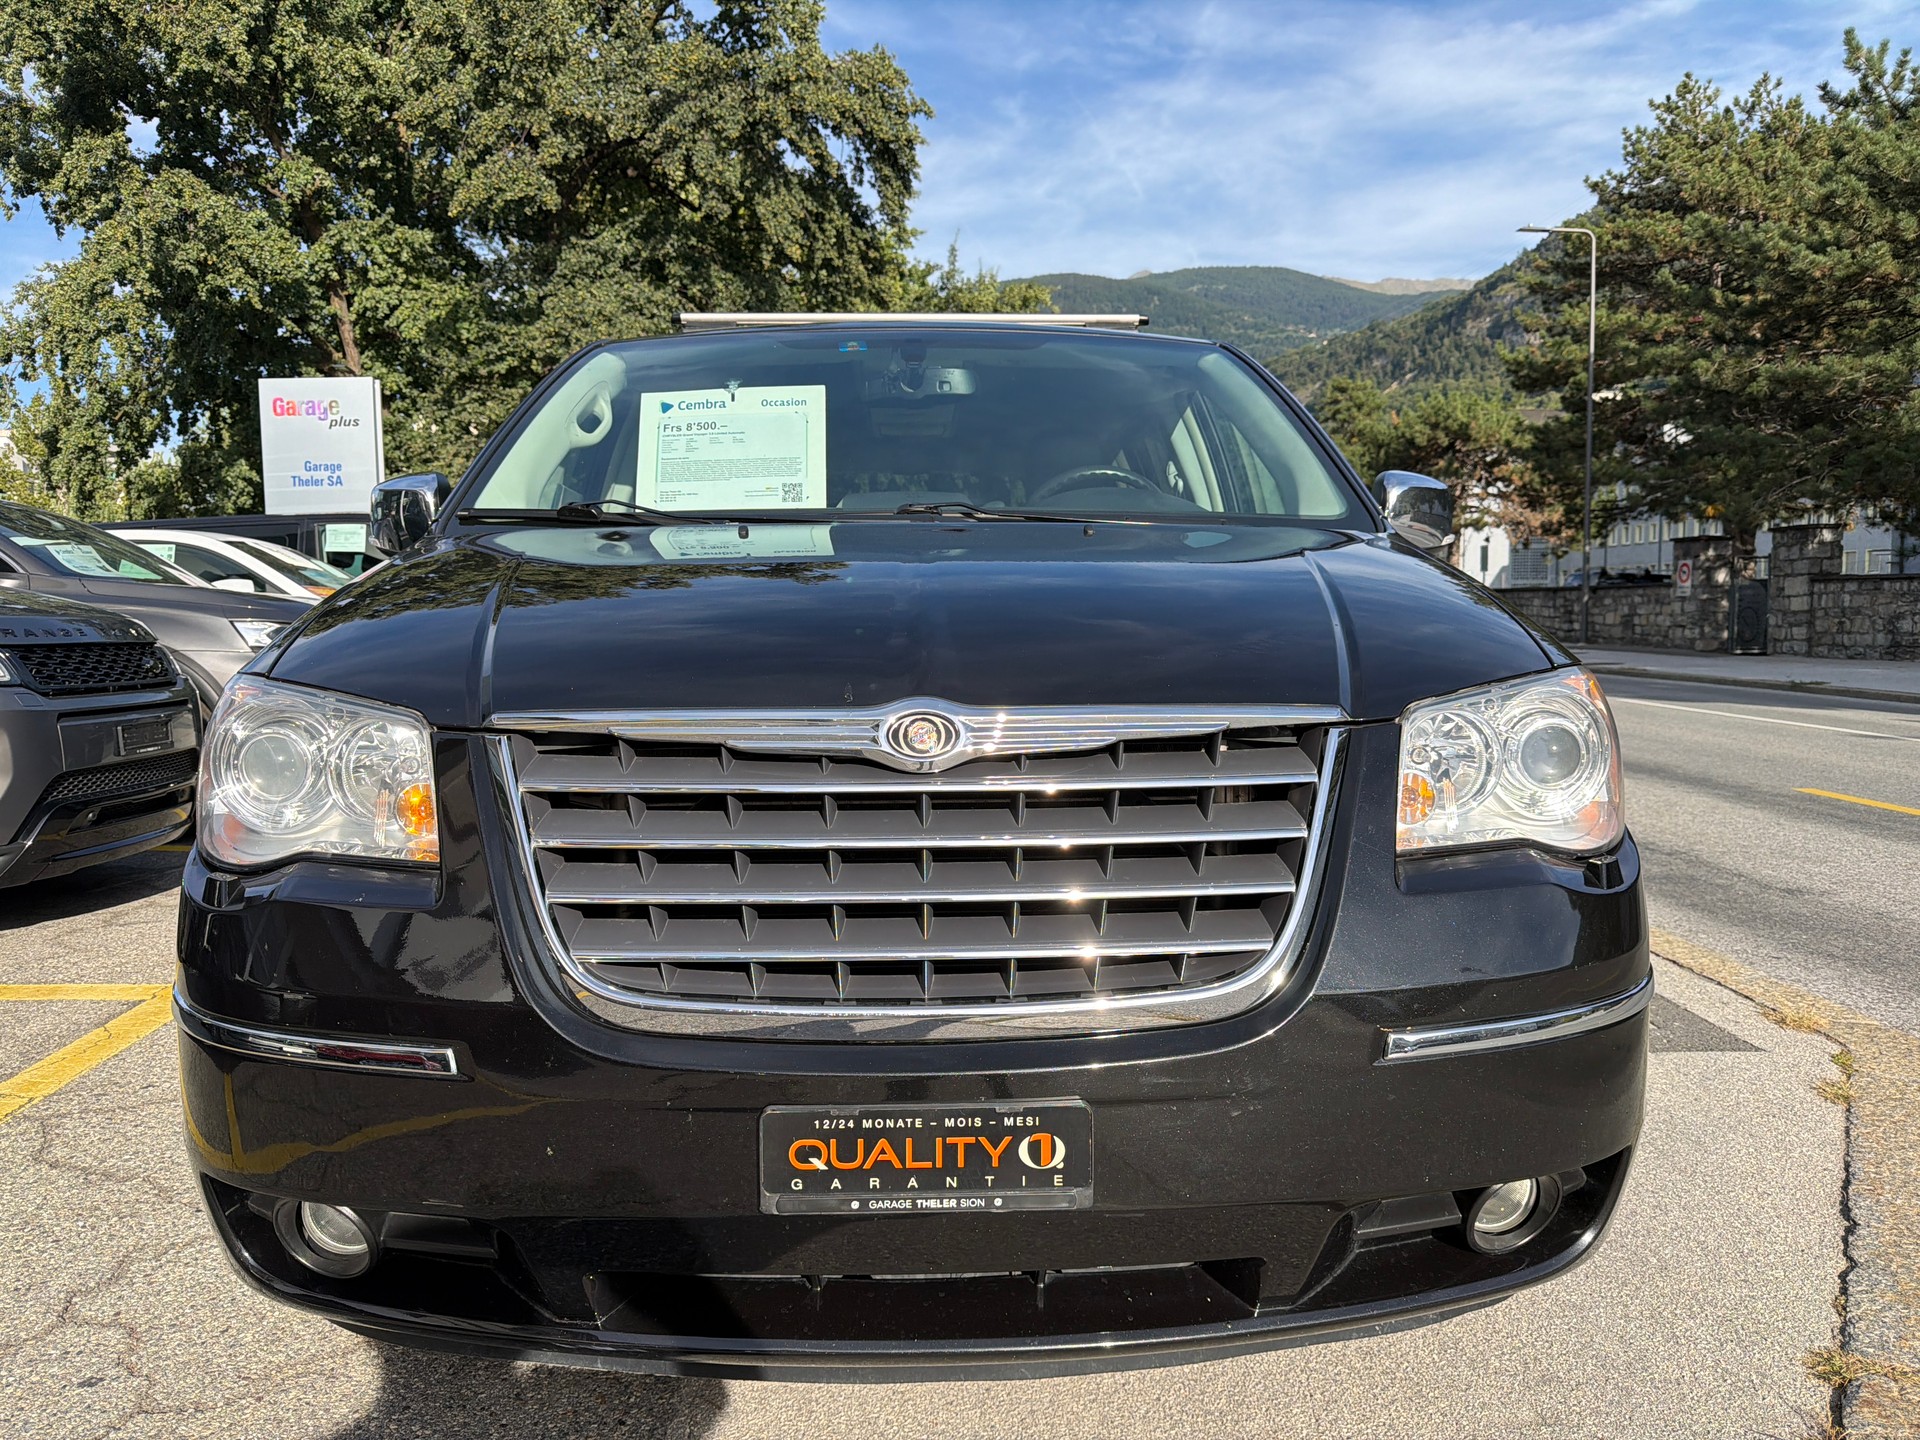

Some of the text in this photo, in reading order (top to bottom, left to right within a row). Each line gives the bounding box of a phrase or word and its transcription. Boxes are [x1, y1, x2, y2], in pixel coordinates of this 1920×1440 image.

[272, 397, 340, 421] Garage
[678, 399, 726, 411] Cembra
[761, 398, 807, 407] Occasion
[329, 416, 360, 430] plus
[663, 423, 682, 433] Frs
[304, 460, 342, 474] Garage
[291, 475, 343, 487] Theler SA
[814, 1119, 854, 1129] 12/24
[862, 1118, 923, 1128] MONATE
[945, 1117, 982, 1127] MOIS
[1004, 1116, 1039, 1126] MESI
[788, 1136, 1013, 1170] QUALITY
[791, 1174, 1063, 1190] GARANTIE
[869, 1198, 985, 1209] GARAGE THELER SION
